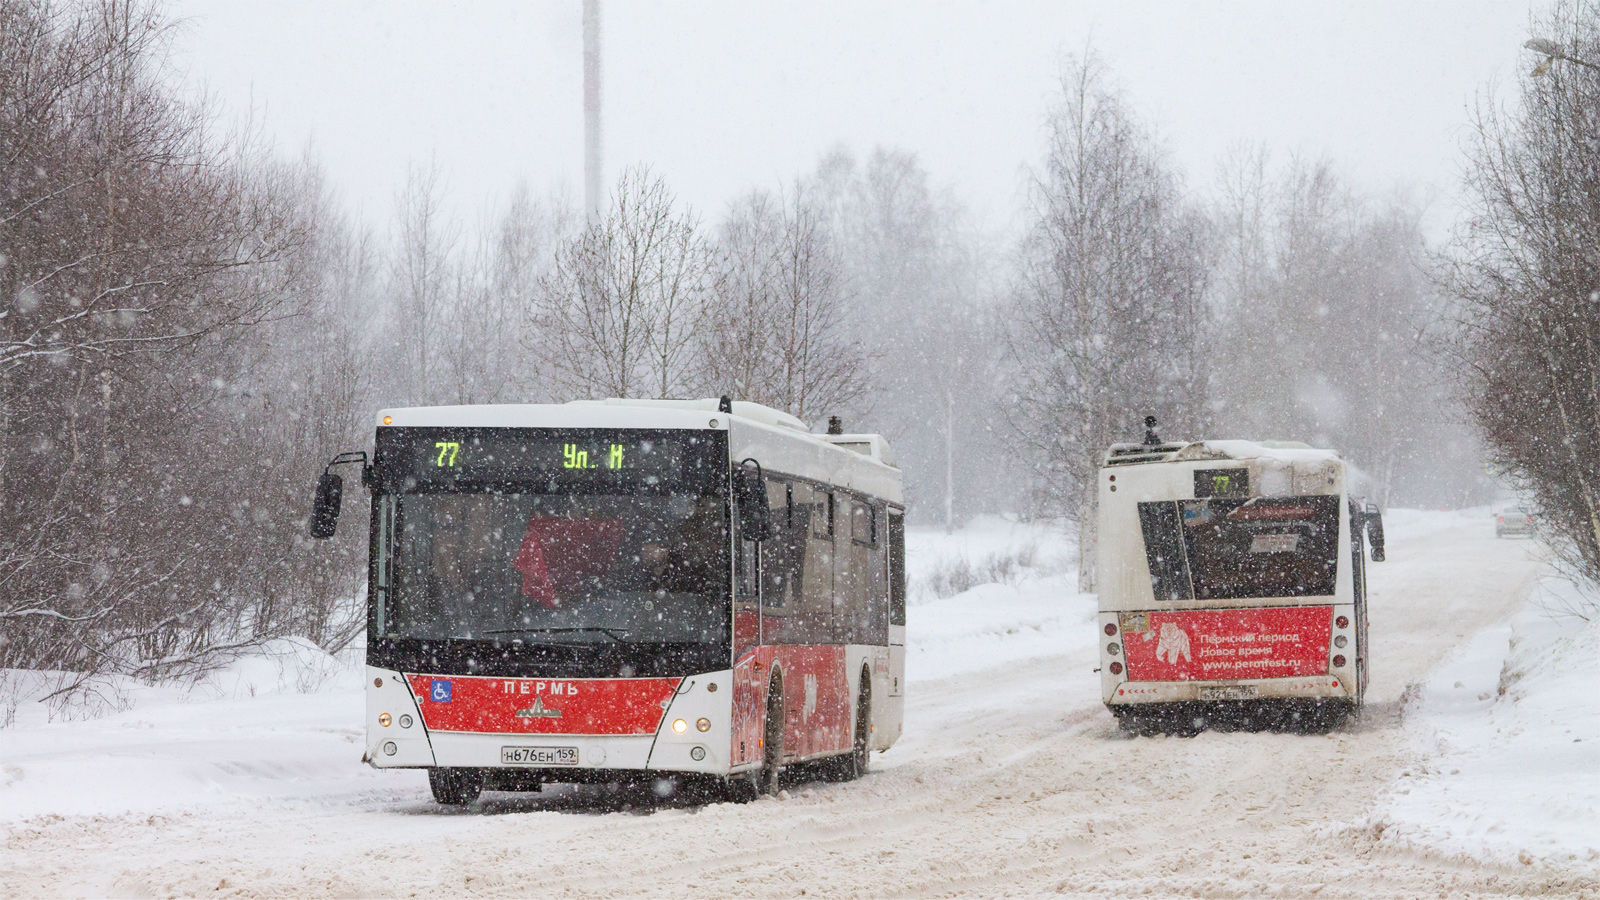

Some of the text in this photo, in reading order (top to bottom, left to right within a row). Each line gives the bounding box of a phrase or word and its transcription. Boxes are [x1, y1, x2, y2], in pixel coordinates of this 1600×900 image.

[435, 442, 459, 467] 77
[564, 443, 623, 469] Ул. М
[1213, 475, 1230, 493] 77
[1200, 632, 1300, 645] Пермский период
[1200, 646, 1273, 657] Новое время
[1202, 658, 1301, 671] www.permfest.ru
[504, 680, 579, 696] ПЕРМЬ
[556, 748, 575, 759] 159
